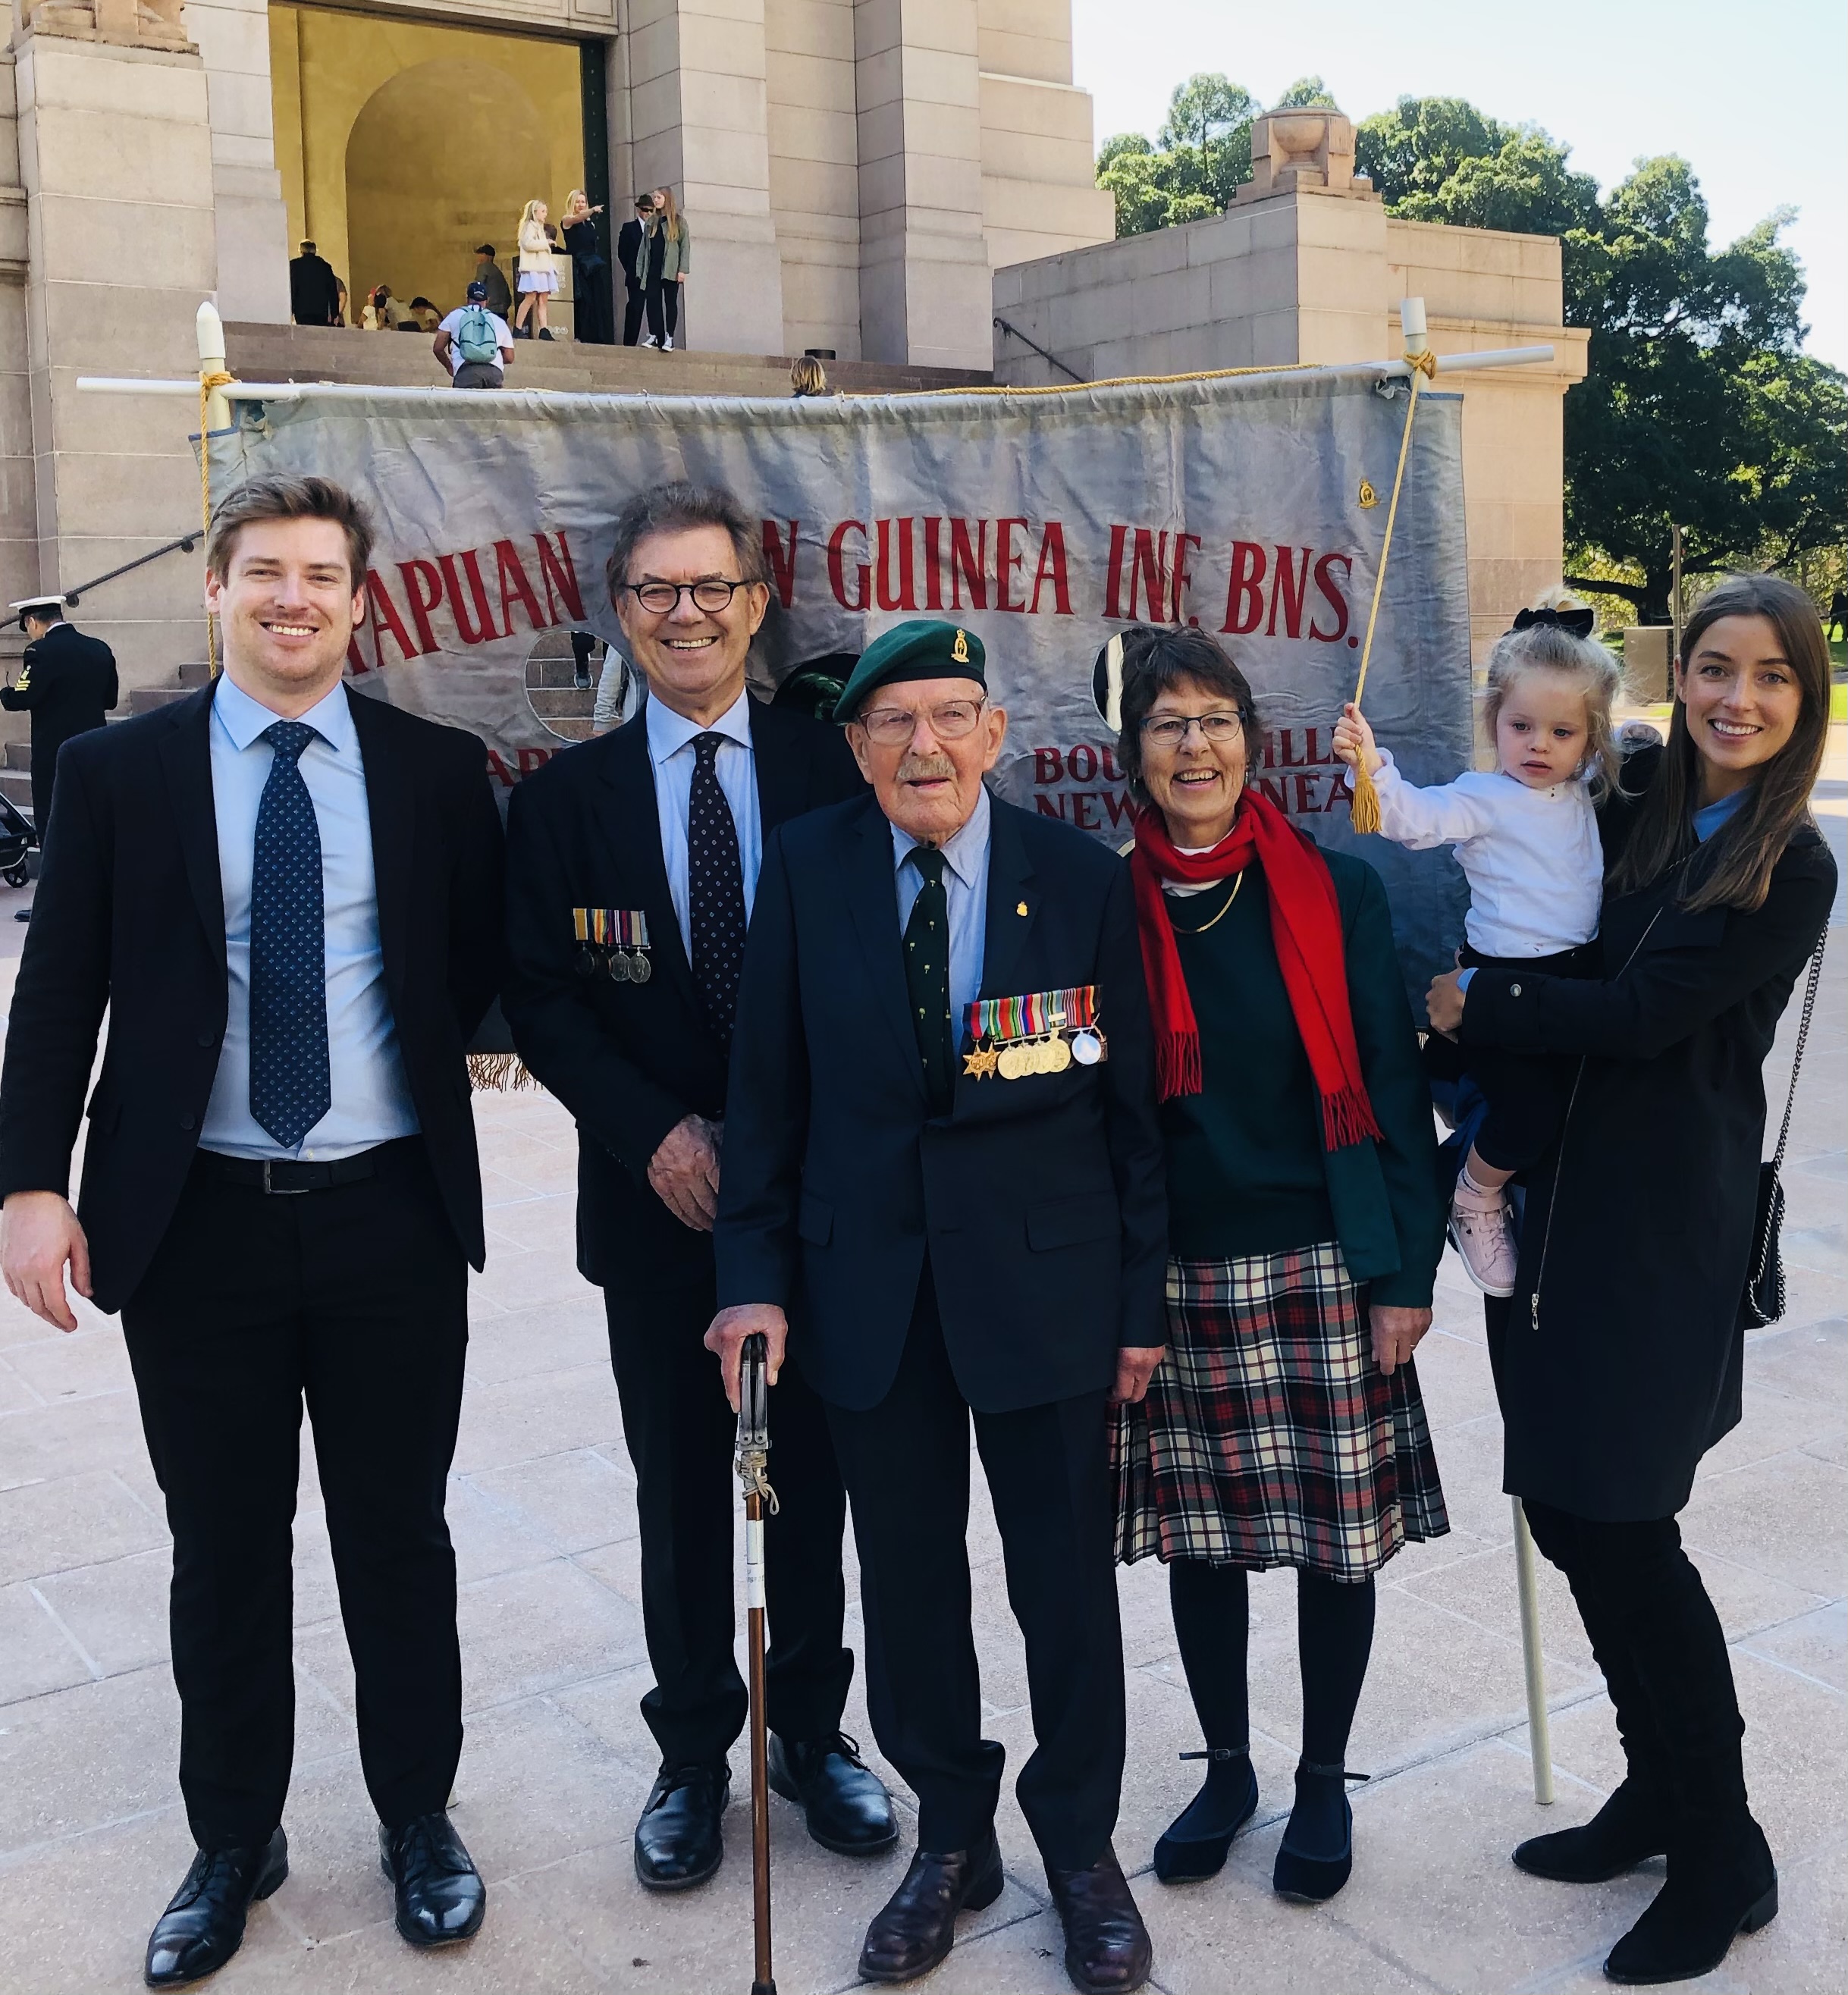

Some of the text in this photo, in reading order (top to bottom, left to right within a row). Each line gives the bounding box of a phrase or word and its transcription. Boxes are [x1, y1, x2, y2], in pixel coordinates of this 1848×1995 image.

[827, 516, 1075, 615] GUINEA
[1101, 525, 1201, 629] INF.
[1217, 541, 1359, 649] BNS.
[1033, 790, 1141, 830] NEW
